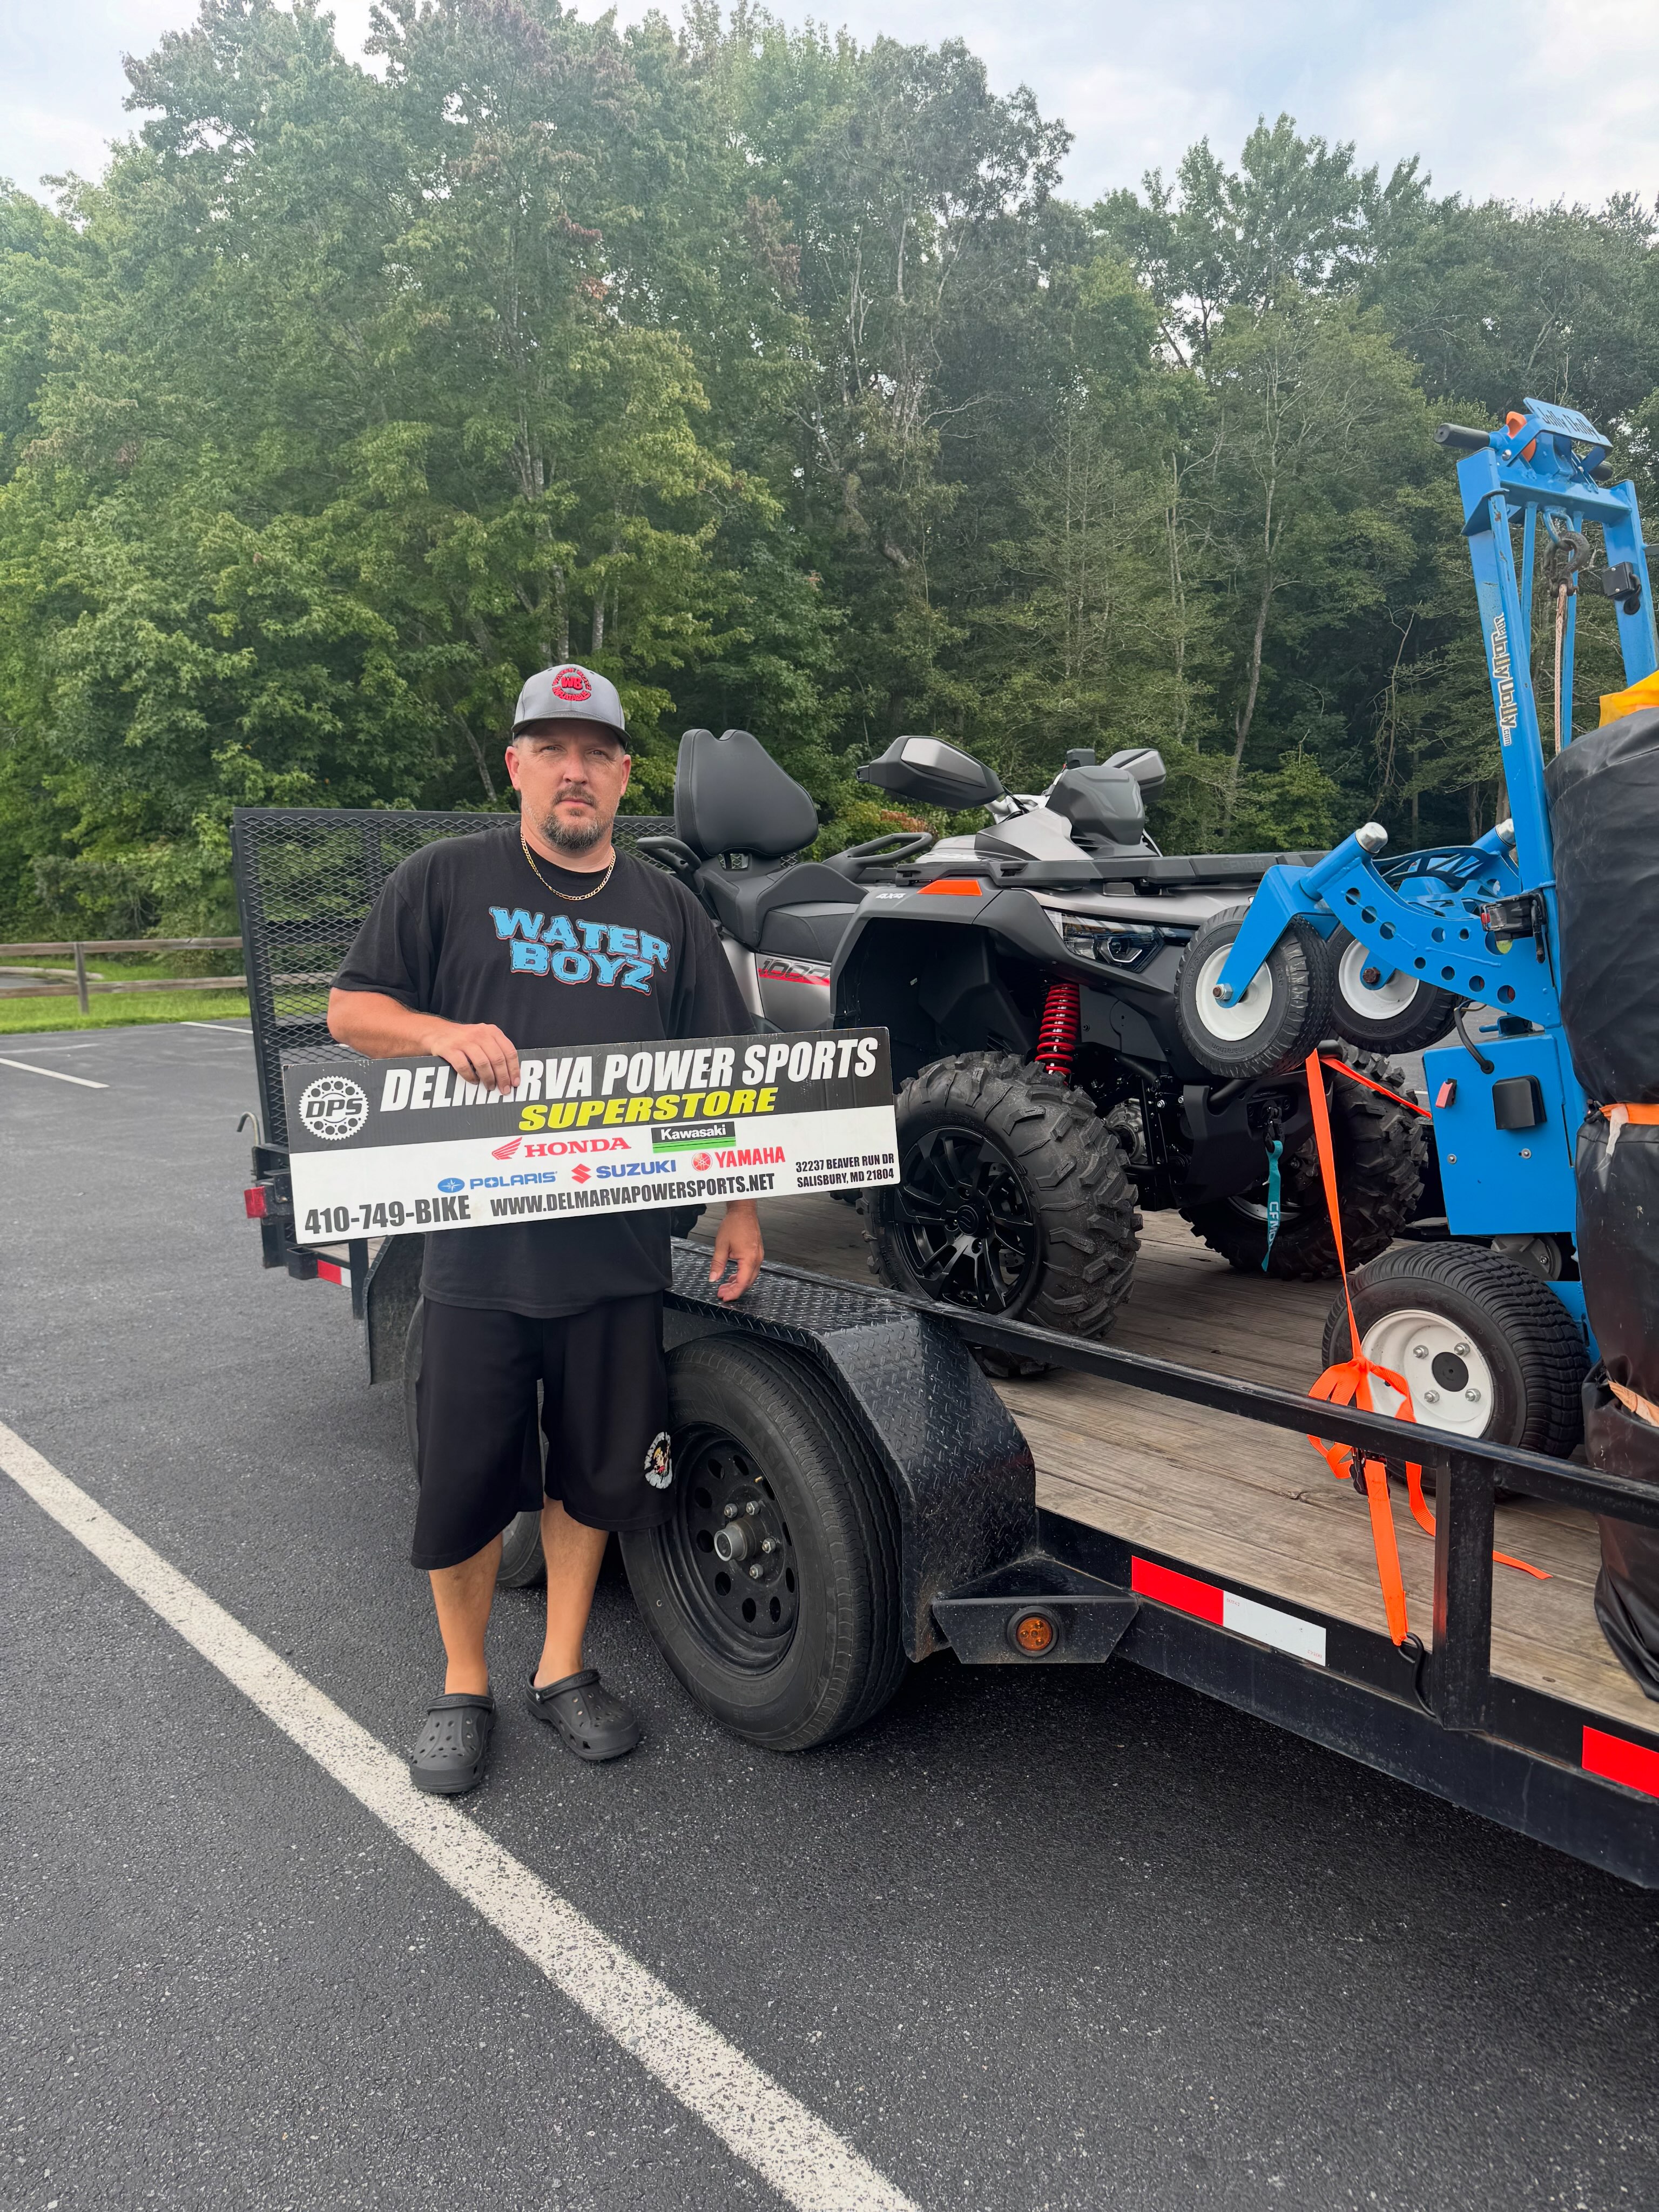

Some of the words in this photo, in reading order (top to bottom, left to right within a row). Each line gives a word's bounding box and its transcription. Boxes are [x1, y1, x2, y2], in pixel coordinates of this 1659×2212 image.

[1537, 407, 1572, 434] Jolly
[1562, 414, 1601, 441] Dolly
[561, 676, 583, 690] WB
[489, 906, 671, 972] WATER
[510, 938, 654, 995] BOYZ
[602, 1047, 736, 1095] POWER
[742, 1037, 878, 1085] SPORTS
[306, 1098, 363, 1118] DPS
[518, 1087, 779, 1131] SUPERSTORE
[661, 1124, 726, 1141] Kawasaki
[524, 1137, 631, 1157] HONDA
[714, 1146, 786, 1168] YAMAHA
[596, 1159, 677, 1179] SUZUKI
[795, 1159, 824, 1172] 32237
[826, 1156, 860, 1170] BEAVER
[862, 1155, 880, 1166] RUN
[882, 1153, 894, 1164] DR
[470, 1171, 556, 1189] POLARIS
[797, 1172, 848, 1188] SALISBURY,
[850, 1171, 864, 1183] MD
[866, 1168, 894, 1181] 21804
[305, 1195, 471, 1235] 410-749-BIKE
[490, 1172, 775, 1217] WWW.DELMARVAPOWERSPORTS.NET
